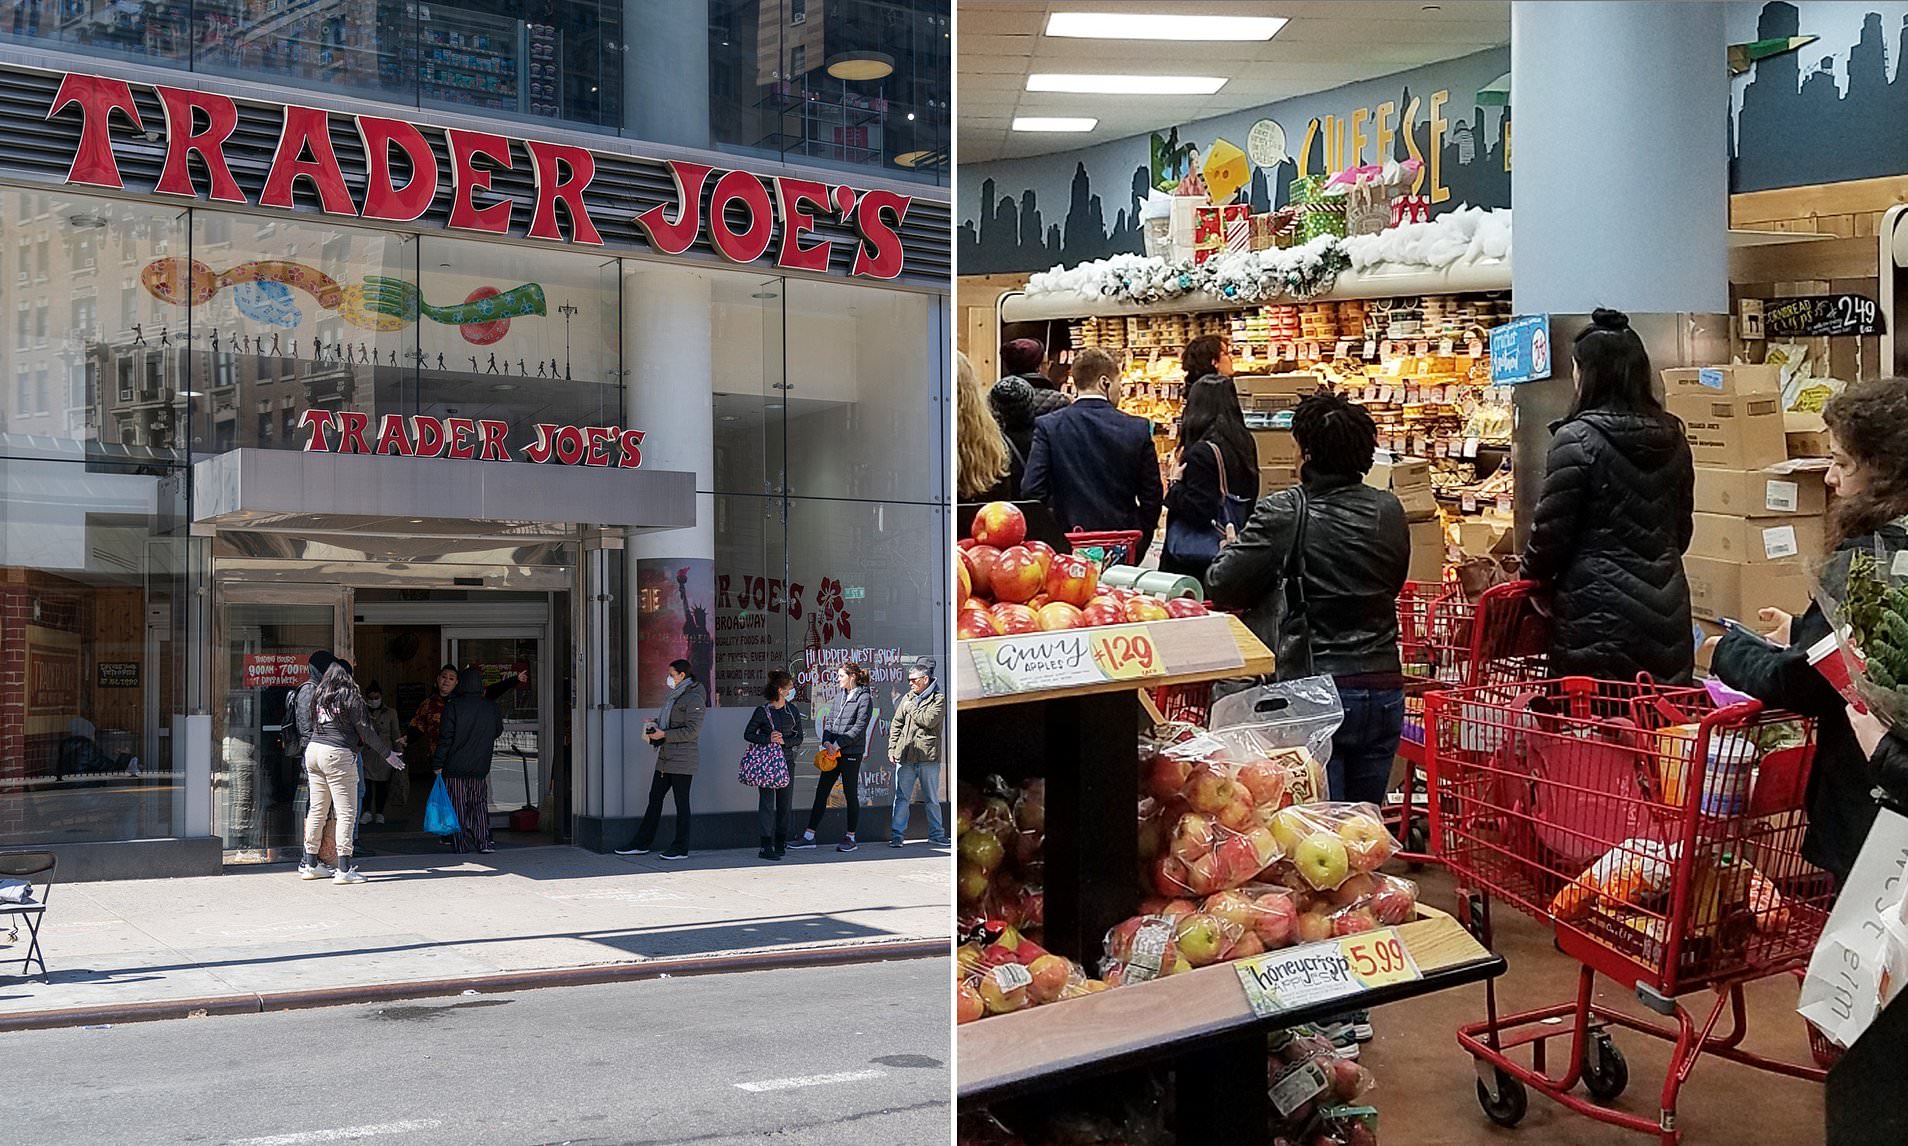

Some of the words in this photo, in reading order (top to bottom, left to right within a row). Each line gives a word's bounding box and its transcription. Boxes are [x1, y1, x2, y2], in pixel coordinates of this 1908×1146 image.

[1297, 89, 1451, 204] CHEESE
[45, 72, 604, 245] TRADER
[631, 159, 912, 280] JOE'S
[1838, 296, 1876, 326] 2.49
[297, 408, 513, 462] TRADER
[519, 423, 647, 469] JOE'S
[737, 575, 805, 621] JOE'S
[715, 614, 766, 631] BROADWAY
[740, 635, 759, 646] FOODS
[760, 634, 772, 645] AD
[805, 648, 816, 669] HI
[818, 647, 849, 667] UPPER
[850, 647, 875, 664] WEST
[877, 647, 903, 666] SIDE!
[1025, 660, 1064, 673] APPLES
[797, 670, 819, 687] OUR
[868, 667, 905, 682] RADING
[1249, 953, 1350, 991] honeycrisp
